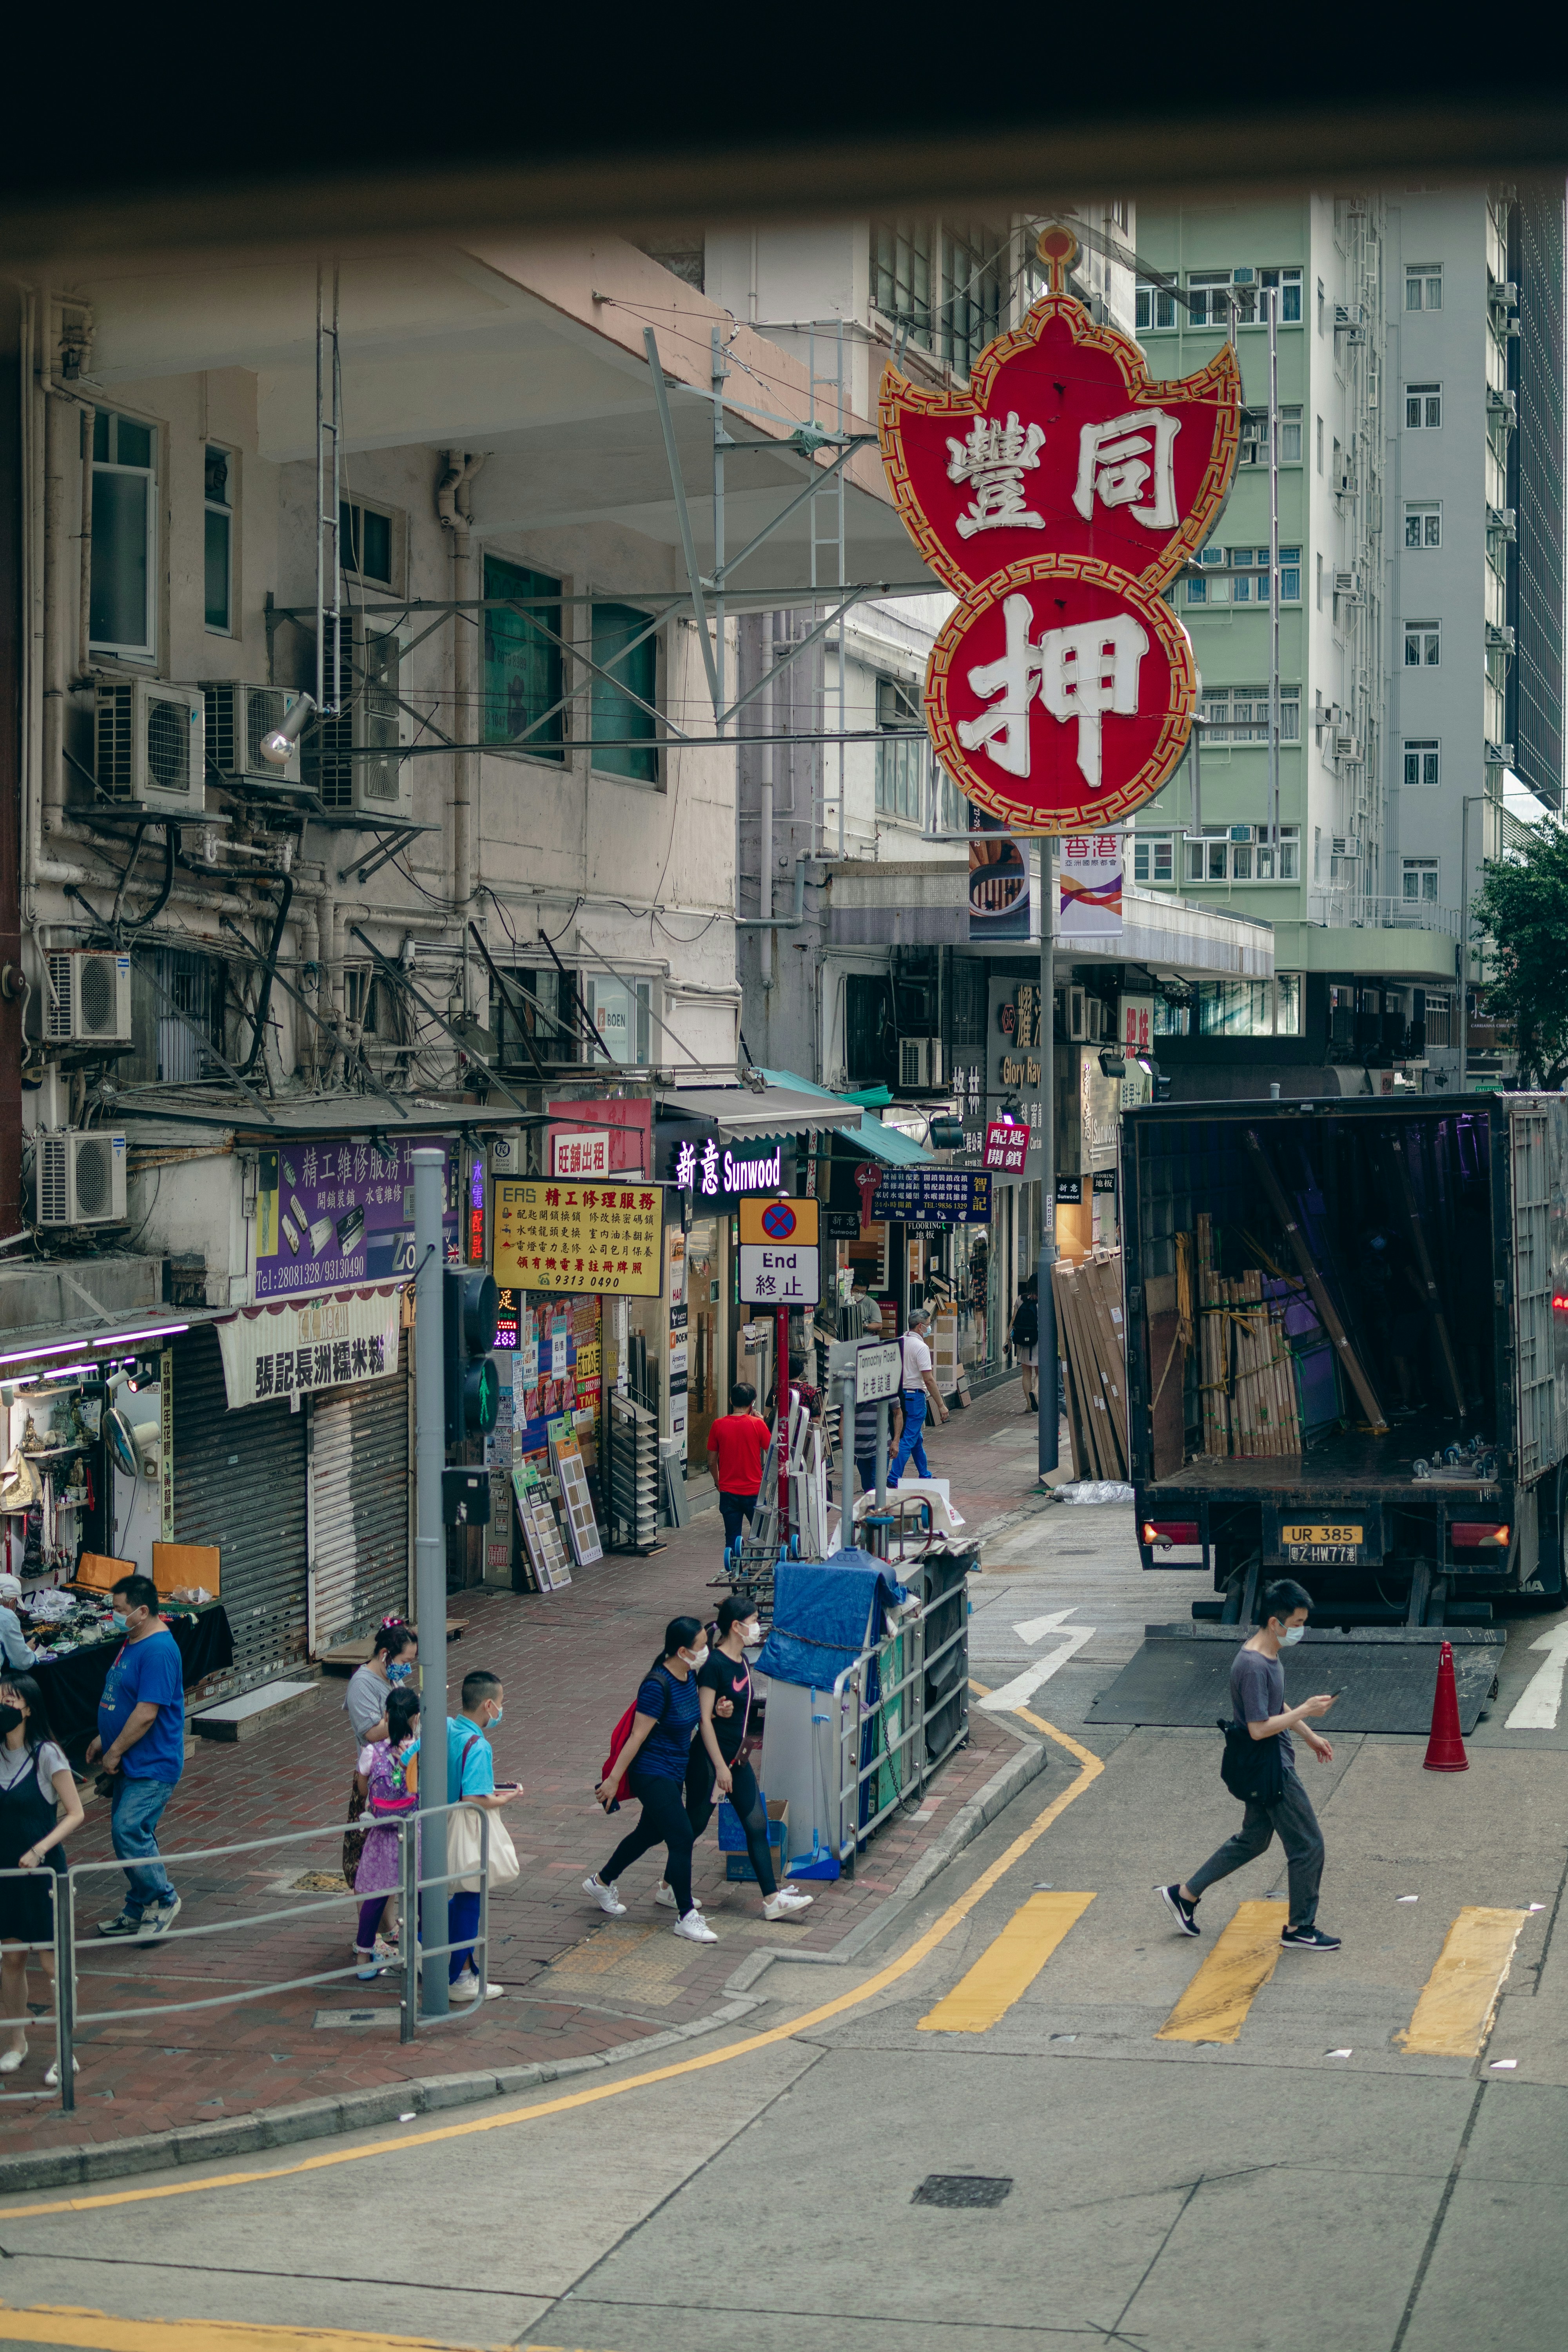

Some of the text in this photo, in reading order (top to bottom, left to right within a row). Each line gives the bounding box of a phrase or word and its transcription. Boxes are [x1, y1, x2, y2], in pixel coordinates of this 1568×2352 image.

[956, 593, 1151, 788] 押
[1065, 835, 1117, 858] 香港
[607, 1014, 625, 1027] BOEN
[1004, 1056, 1041, 1090] Glory Ray
[990, 1129, 1025, 1146] 配匙
[677, 1138, 719, 1194] 新意
[987, 1149, 1023, 1167] 開鎖
[724, 1146, 780, 1192] Sunwood
[1059, 1183, 1078, 1192] 新意
[1095, 1179, 1112, 1187] 地板
[317, 1183, 402, 1210] 開鎖裝鎖 水電維修
[544, 1187, 656, 1211] 精工修理服務
[973, 1177, 987, 1211] 智記
[517, 1209, 654, 1226] 配匙開鎖換鎖 修改換密碼鎖
[832, 1216, 855, 1226] 新意
[516, 1225, 581, 1238] 水喉龍頭更換
[915, 1230, 935, 1239] 地板
[516, 1241, 653, 1258] 電燈電力急修 公司包月保養
[516, 1256, 642, 1275] 領有機電署註冊牌照
[763, 1252, 797, 1269] End
[256, 1256, 364, 1292] Tel:28081328/93130490
[555, 1275, 619, 1288] 9313 0490
[755, 1274, 803, 1296] 終止
[676, 1332, 688, 1343] BOEN
[577, 1348, 601, 1379] 成立公司
[672, 1355, 686, 1365] Armstrong
[858, 1348, 896, 1369] Tonnochy Road
[863, 1372, 891, 1397] 杜老誌道
[579, 1393, 598, 1407] TML
[1292, 1528, 1352, 1541] UR 385
